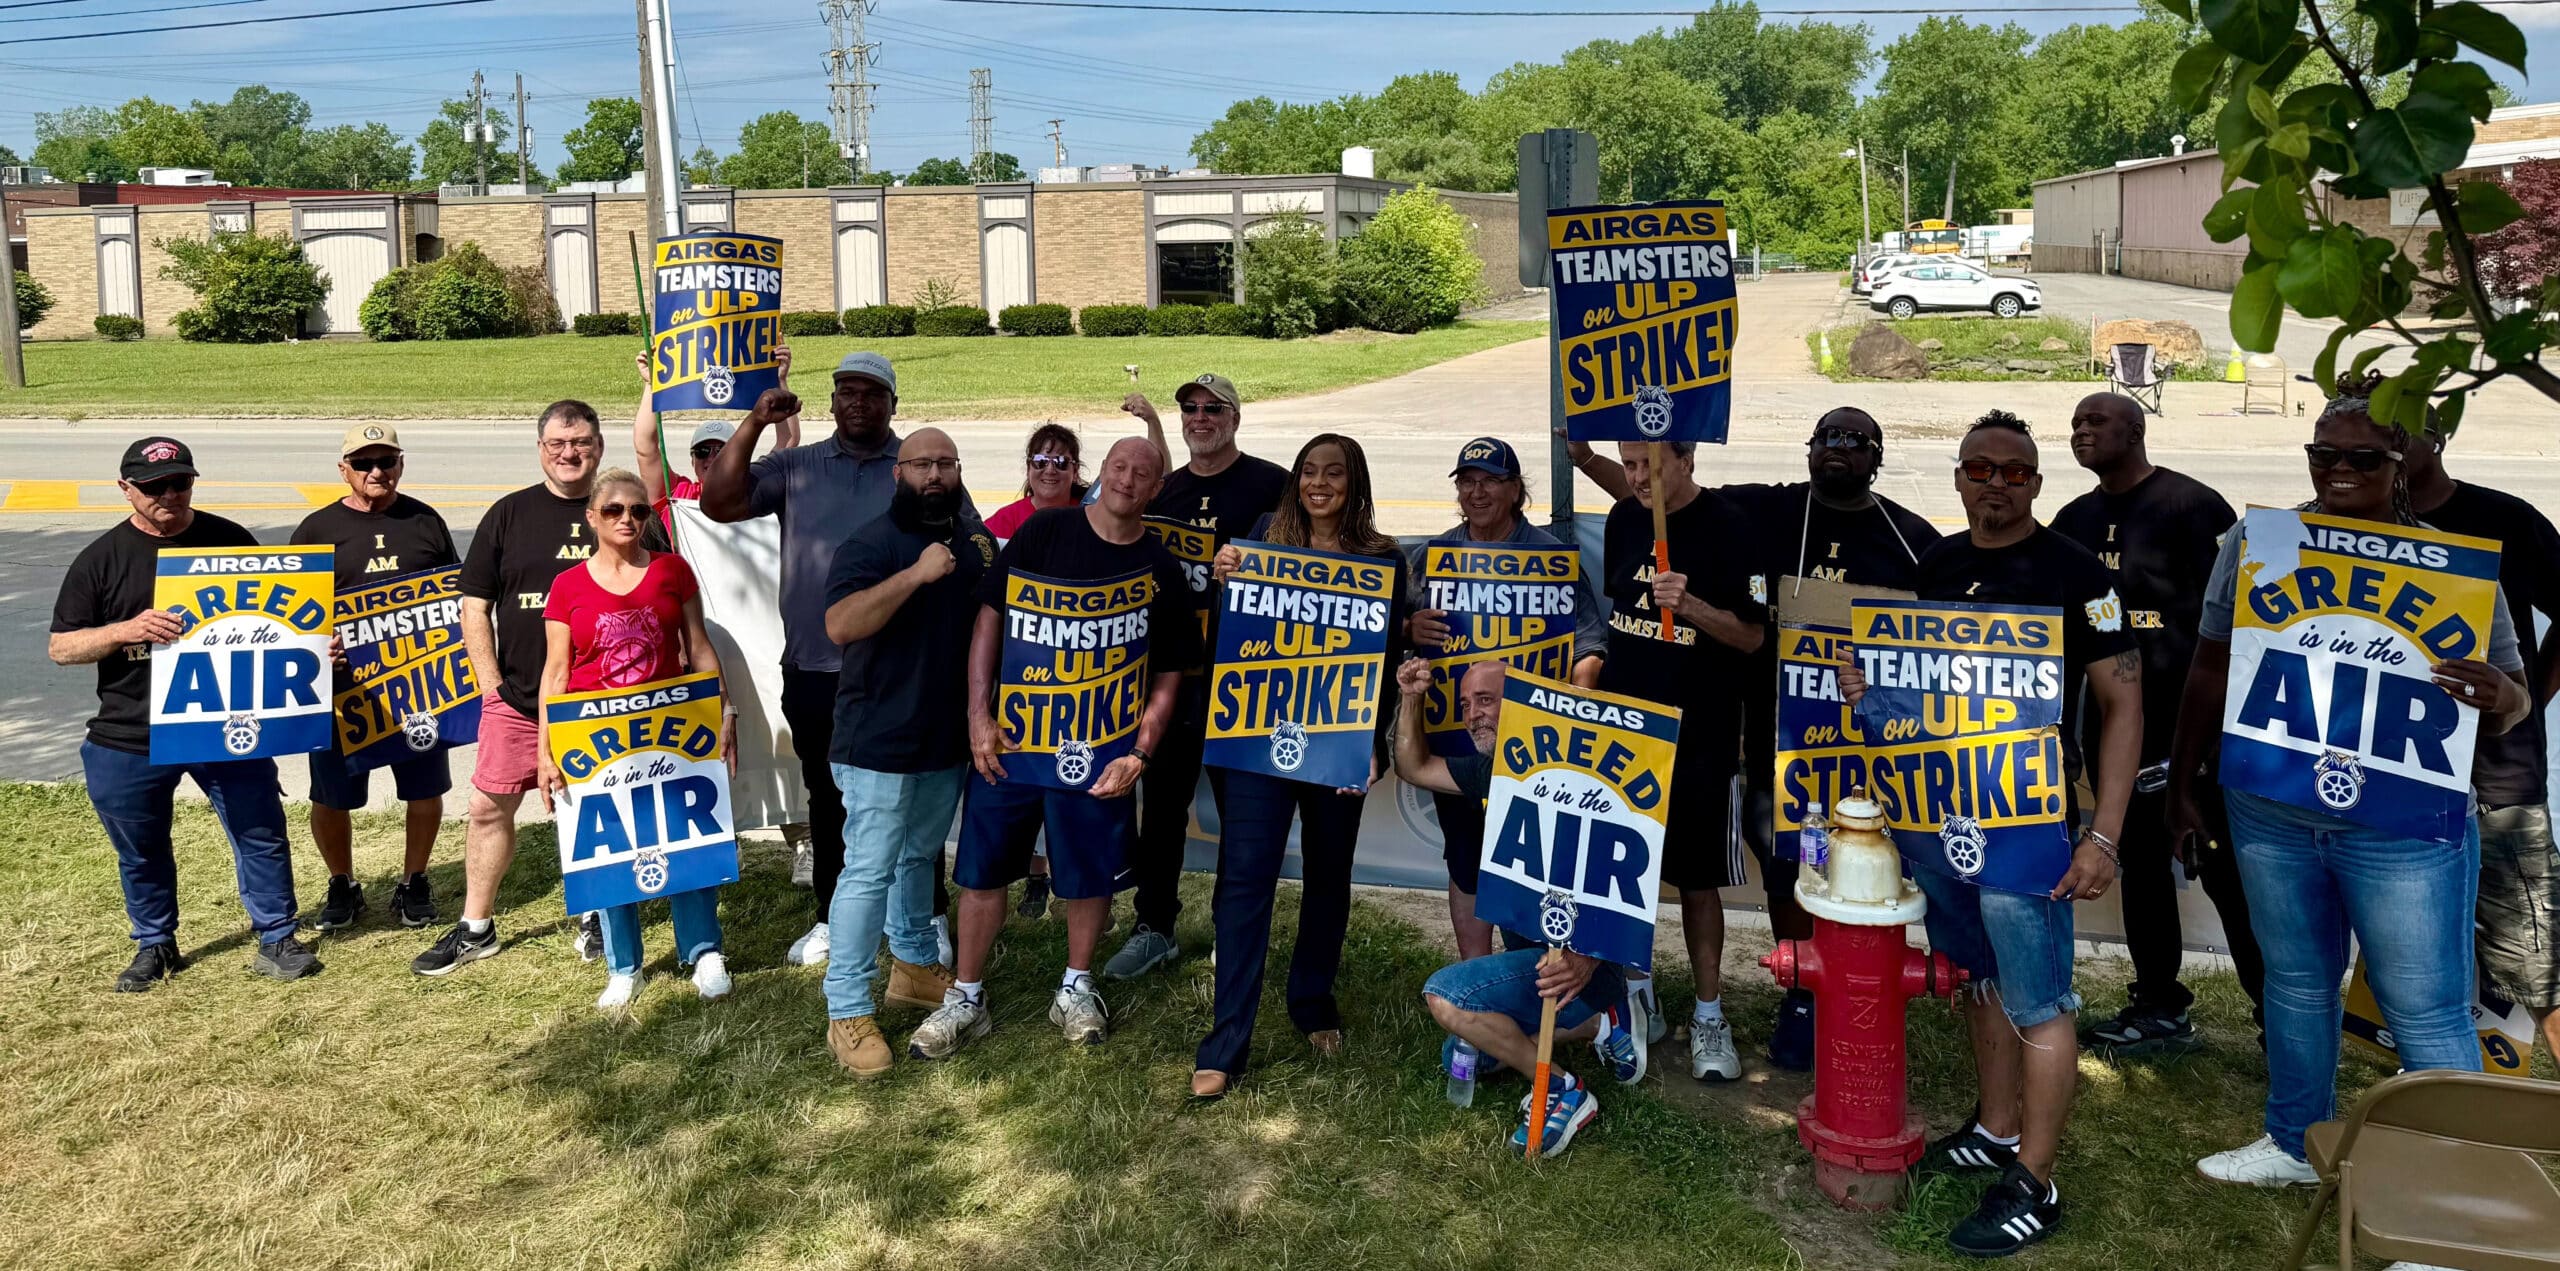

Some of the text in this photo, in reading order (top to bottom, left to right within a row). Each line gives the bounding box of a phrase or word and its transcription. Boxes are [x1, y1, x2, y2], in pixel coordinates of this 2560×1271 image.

[1562, 212, 1716, 243] AIRGAS
[665, 241, 777, 263] AIRGAS
[1556, 245, 1729, 284] TEAMSTERS
[659, 265, 780, 295] TEAMSTERS
[671, 290, 759, 325] on ULP
[1583, 280, 1697, 329] on ULP
[657, 316, 777, 384] STRIKE!
[1568, 308, 1733, 408] STRIKE!
[1200, 496, 1210, 510] I
[375, 534, 385, 548] I
[570, 523, 581, 537] I
[2107, 525, 2116, 541] I
[188, 555, 303, 574] AIRGAS
[365, 556, 399, 573] AM
[556, 544, 592, 559] AM
[1435, 552, 1570, 576] AIRGAS
[1828, 543, 1840, 558] I
[1240, 553, 1383, 591] AIRGAS
[1811, 564, 1847, 583] AM
[166, 580, 326, 635] GREED
[334, 573, 462, 619] AIRGAS
[1016, 580, 1147, 612] AIRGAS
[1228, 581, 1387, 633] TEAMSTERS
[1428, 580, 1575, 616] TEAMSTERS
[1635, 592, 1650, 610] A
[2248, 565, 2477, 661] GREED
[203, 623, 281, 646] is in the
[1008, 608, 1149, 650] TEAMSTERS
[1240, 620, 1351, 658] on ULP
[1443, 614, 1546, 654] on ULP
[1866, 613, 2050, 649] AIRGAS
[2299, 624, 2407, 666] is in the
[353, 628, 450, 683] on ULP
[1023, 646, 1127, 683] on ULP
[161, 647, 322, 715] AIR
[1859, 649, 2059, 701] TEAMSTERS
[343, 648, 480, 745] STRIKE
[580, 685, 690, 718] AIRGAS
[1003, 665, 1145, 748] STRIKE!
[1214, 661, 1378, 732] STRIKE!
[1529, 688, 1645, 731] AIRGAS
[2237, 647, 2460, 778] AIR
[1804, 725, 1838, 745] on
[1883, 693, 2017, 741] on ULP
[561, 716, 718, 779] GREED
[603, 755, 677, 788] is in the
[1503, 725, 1662, 811] GREED
[1872, 736, 2061, 824] STRIKE!
[1533, 776, 1612, 814] is in the
[572, 774, 725, 863] AIR
[1490, 794, 1651, 910] AIR
